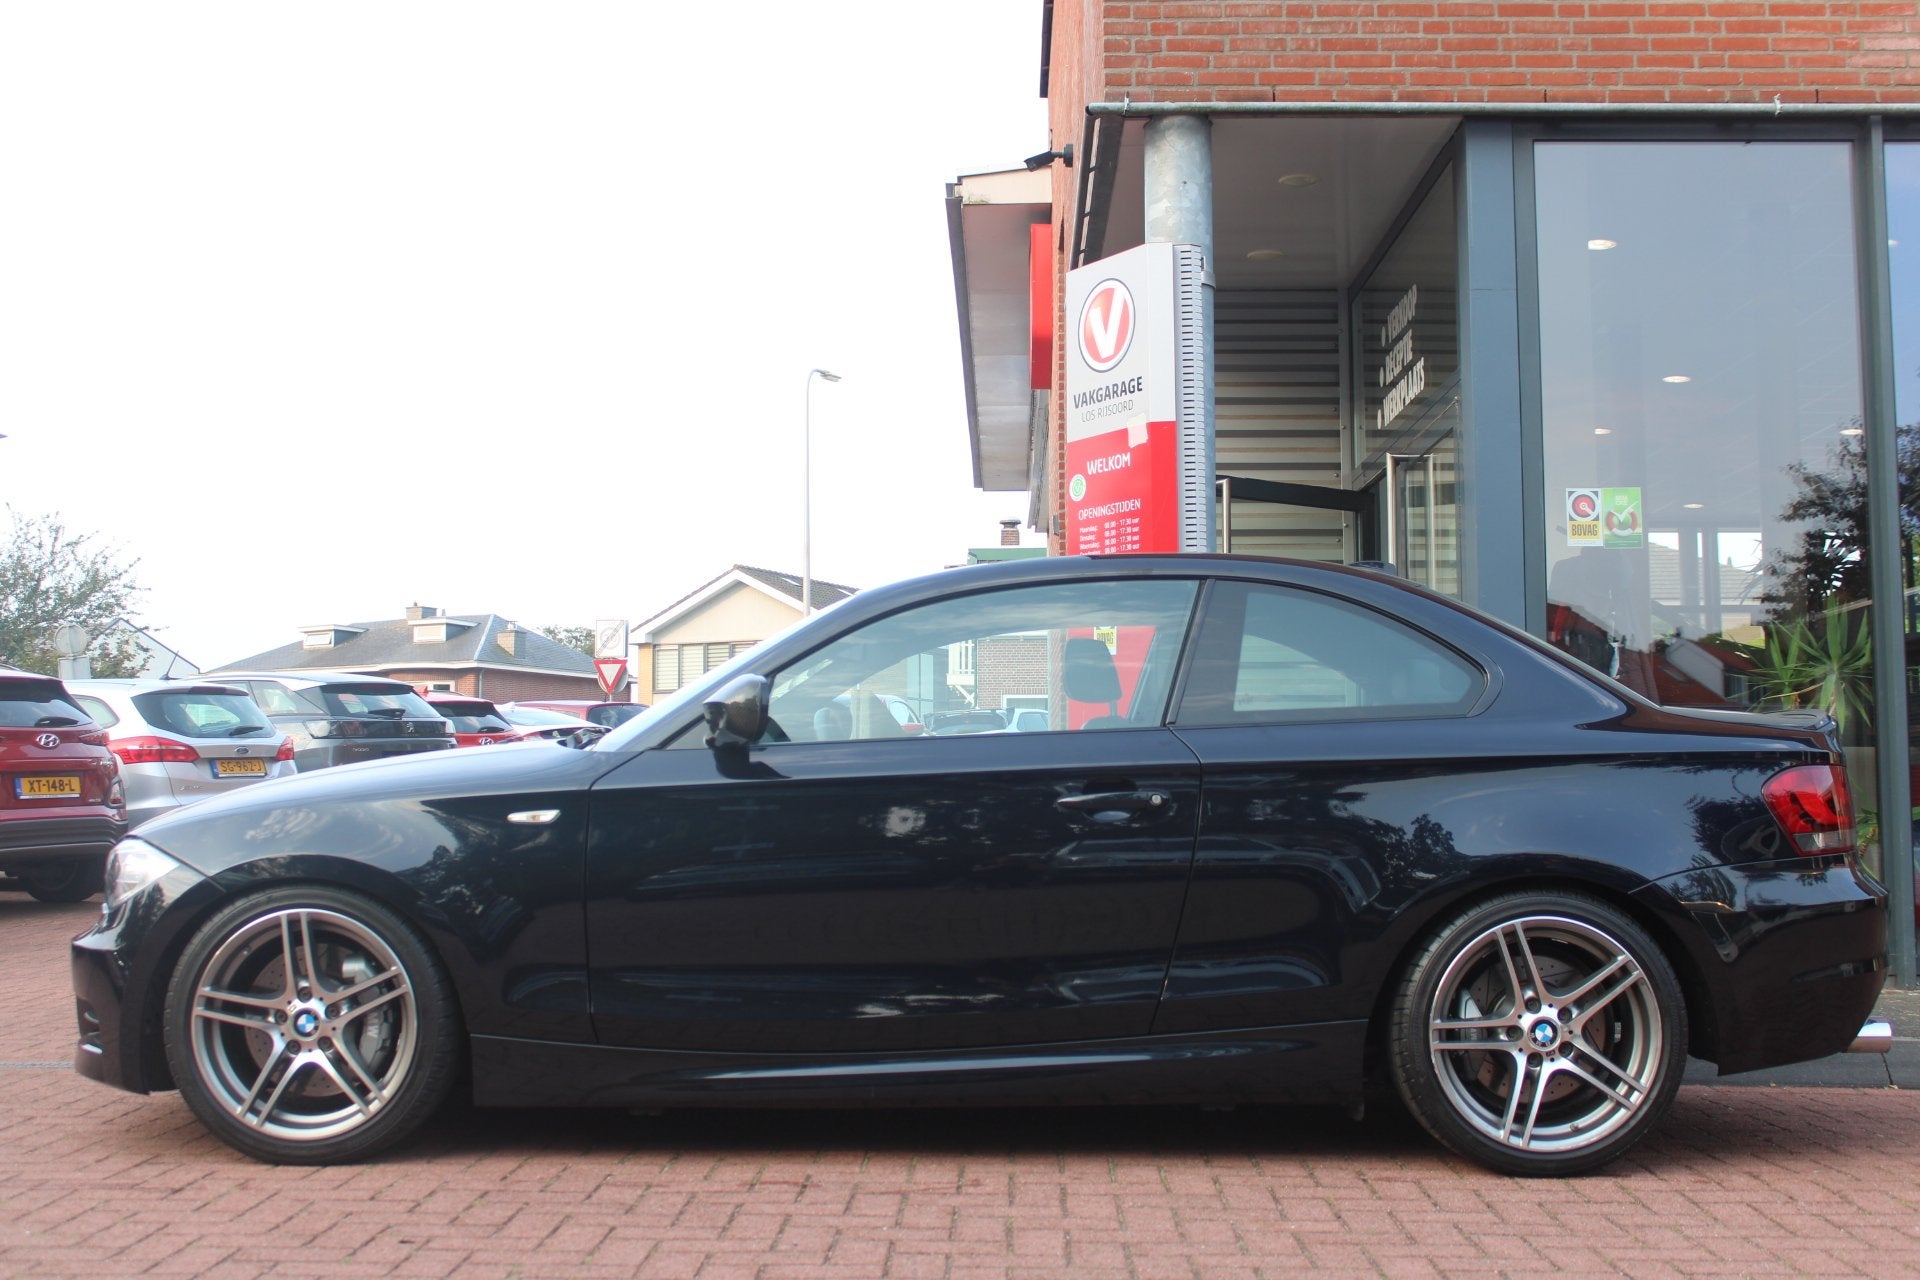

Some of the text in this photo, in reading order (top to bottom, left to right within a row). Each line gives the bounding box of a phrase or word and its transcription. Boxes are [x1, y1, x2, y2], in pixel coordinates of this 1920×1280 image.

[1387, 284, 1417, 343] VERKOOP
[1385, 328, 1413, 386] RECEPTIE
[1073, 376, 1143, 409] VAKGARAGE
[1382, 356, 1425, 427] WERKPLAATS
[1081, 399, 1134, 423] LOS RIJSOORD
[1087, 452, 1131, 475] WELKOM
[1078, 498, 1141, 521] OPENINGSTIJDEN
[1571, 524, 1598, 537] BOVAG
[220, 760, 262, 773] SG-962-J
[27, 779, 75, 793] XT-148-L
